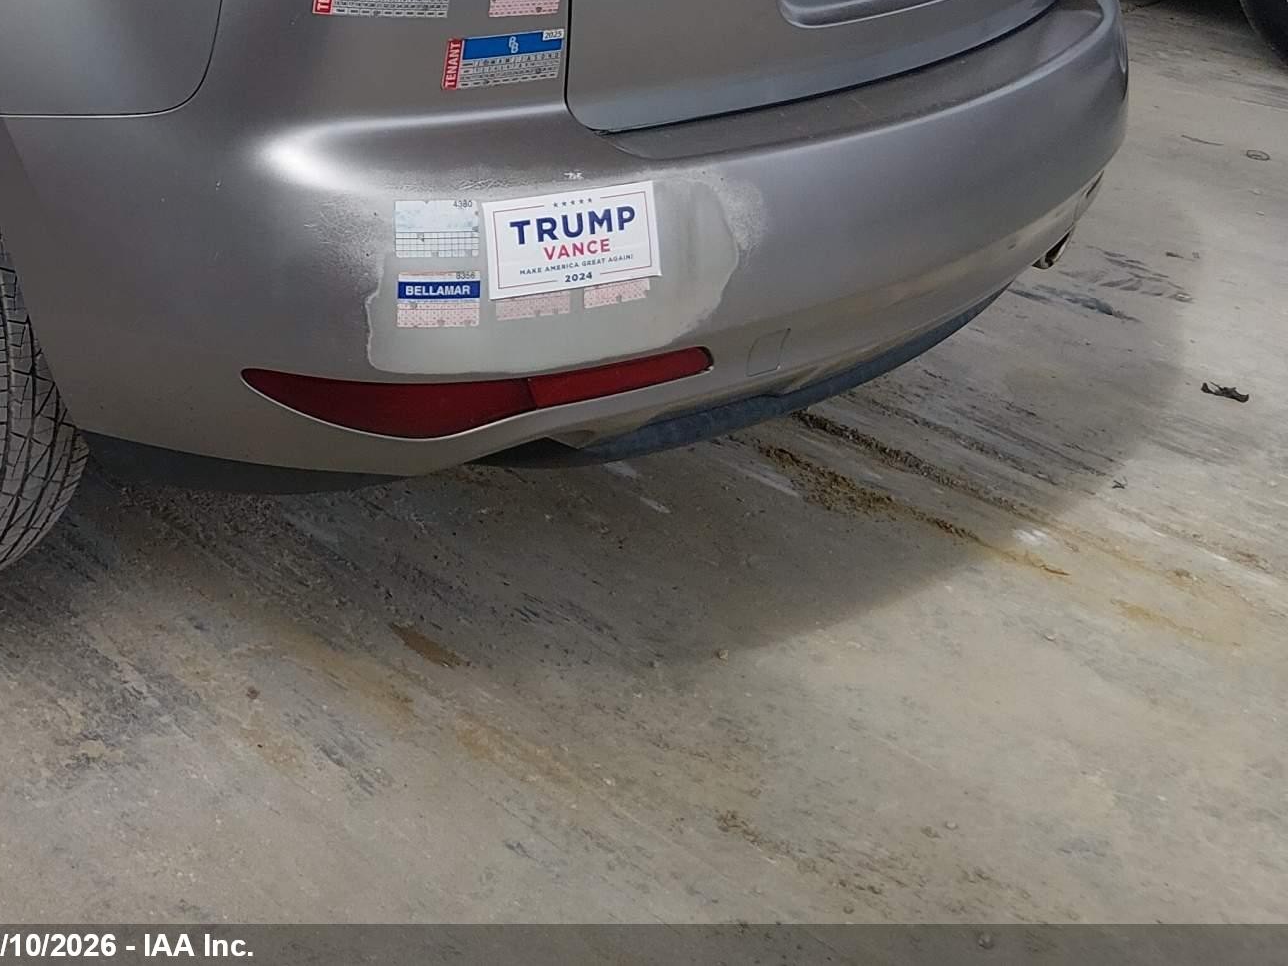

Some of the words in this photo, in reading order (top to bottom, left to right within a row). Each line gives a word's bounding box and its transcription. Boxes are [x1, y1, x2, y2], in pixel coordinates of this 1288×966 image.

[445, 42, 461, 87] TENANT
[509, 205, 636, 245] TRUMP
[544, 238, 611, 261] VANCE
[519, 267, 542, 276] MAKE
[544, 261, 579, 272] AMERICA
[581, 257, 606, 267] GREAT
[564, 272, 593, 283] 2024
[405, 285, 472, 296] BELLAMAR
